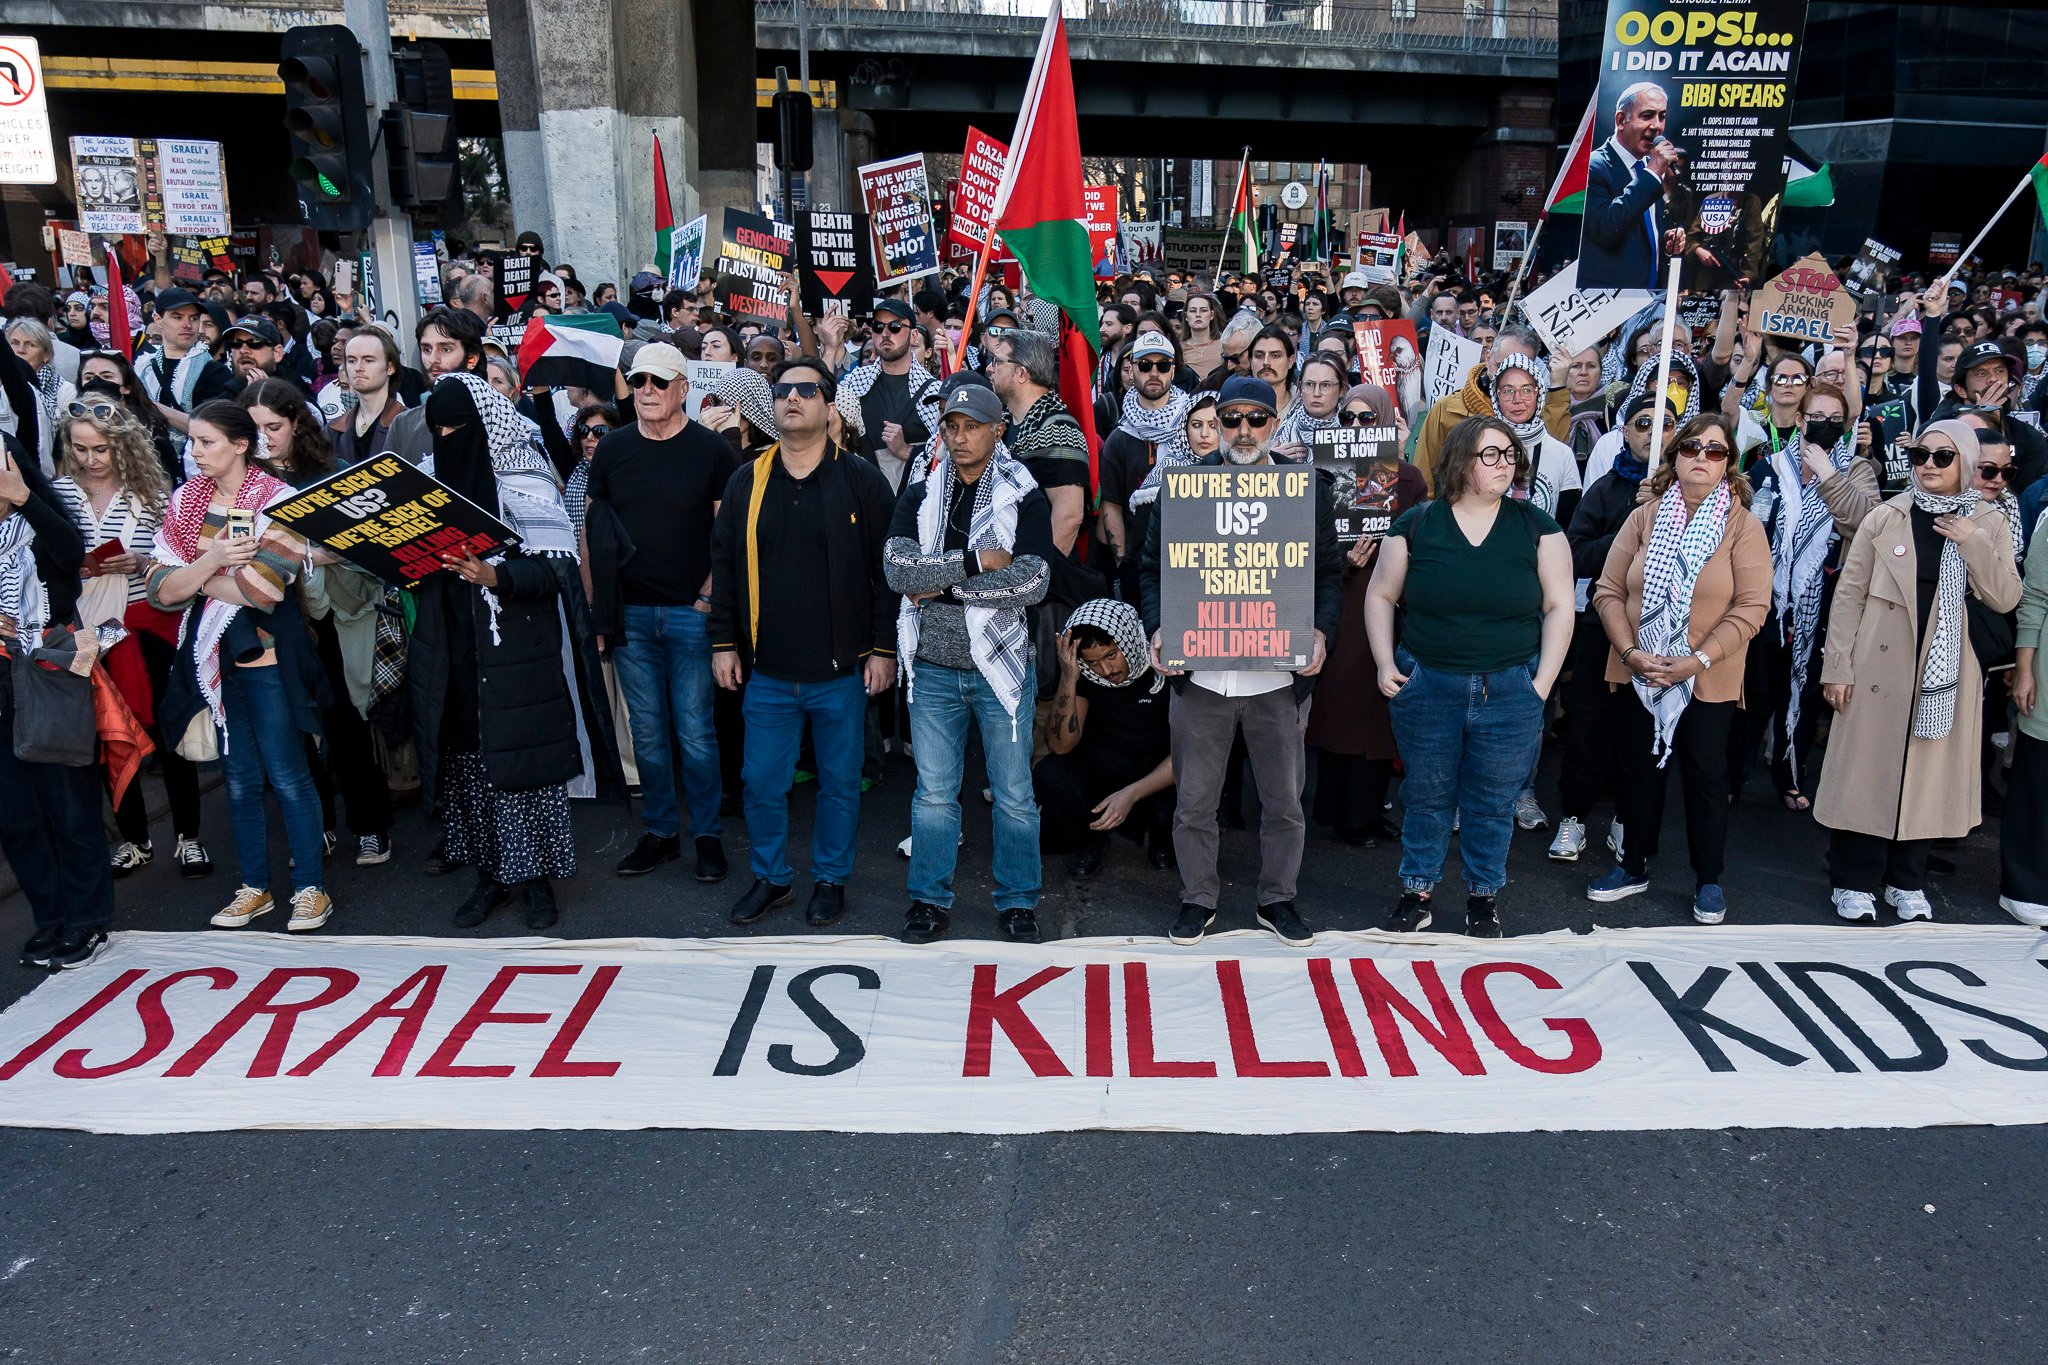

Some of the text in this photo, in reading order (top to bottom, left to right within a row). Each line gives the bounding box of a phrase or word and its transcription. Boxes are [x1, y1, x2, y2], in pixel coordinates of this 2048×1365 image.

[1615, 11, 1794, 46] OOPS!...
[1611, 52, 1790, 72] I DID IT AGAIN
[1681, 84, 1786, 108] BIBI SPEARS
[1708, 117, 1758, 125] OOPS DID IT AGAIN
[105, 146, 130, 154] KNOWS
[93, 157, 121, 165] WANTED
[968, 152, 1005, 181] NURSE
[864, 166, 923, 190] IF WE WERE
[965, 169, 995, 190] DON'T
[876, 180, 917, 199] IN GAZA
[961, 181, 976, 200] TO
[1526, 187, 1536, 196] 22
[891, 195, 904, 207] AS
[965, 200, 981, 219] TO
[1090, 202, 1105, 211] WE
[87, 214, 108, 222] WHAT
[811, 213, 852, 230] DEATH
[877, 202, 921, 223] NURSES
[1705, 212, 1726, 221] USA
[91, 223, 139, 231] REALLY ARE
[772, 221, 794, 242] THE
[875, 213, 929, 236] WE WOULD
[900, 230, 910, 239] BE
[736, 226, 791, 256] GENOCIDE
[811, 232, 853, 249] DEATH
[884, 235, 926, 261] SHOT
[1165, 243, 1208, 253] STUDENT
[1361, 234, 1397, 243] MURDERED
[504, 257, 531, 270] DEATH
[721, 240, 783, 270] DID NOT END
[811, 251, 856, 267] TO THE
[504, 270, 531, 282] DEATH
[718, 257, 757, 281] IT JUST
[503, 281, 531, 295] TO THE
[1775, 268, 1841, 298] STOP
[752, 282, 789, 305] TO THE
[1784, 293, 1835, 309] FUCKING
[729, 293, 788, 321] WESTBANK
[1776, 304, 1829, 320] ARMING
[506, 312, 523, 325] IDF
[1761, 309, 1835, 341] ISRAEL
[1356, 329, 1382, 348] END
[1360, 348, 1384, 369] THE
[697, 367, 722, 379] FREE
[1363, 366, 1396, 387] SIEGE
[957, 390, 969, 402] R
[1315, 426, 1396, 444] NEVER AGAIN
[1334, 443, 1378, 458] IS NOW
[270, 457, 403, 523] YOU'RE SICK OF
[1167, 472, 1309, 498] YOU'RE SICK OF
[332, 488, 391, 520] US?
[323, 488, 453, 551] WE'RE SICK OF
[1215, 502, 1268, 535] US?
[1335, 517, 1392, 532] 45 2025
[368, 511, 444, 550] 'ISRAEL'
[389, 526, 470, 564] KILLING
[1168, 542, 1309, 568] WE'RE SICK OF
[1200, 569, 1277, 595] 'ISRAEL'
[1197, 601, 1276, 629] KILLING
[1183, 629, 1291, 658] CHILDREN!
[0, 958, 2048, 1080] ISRAEL IS KILLING KIDS
